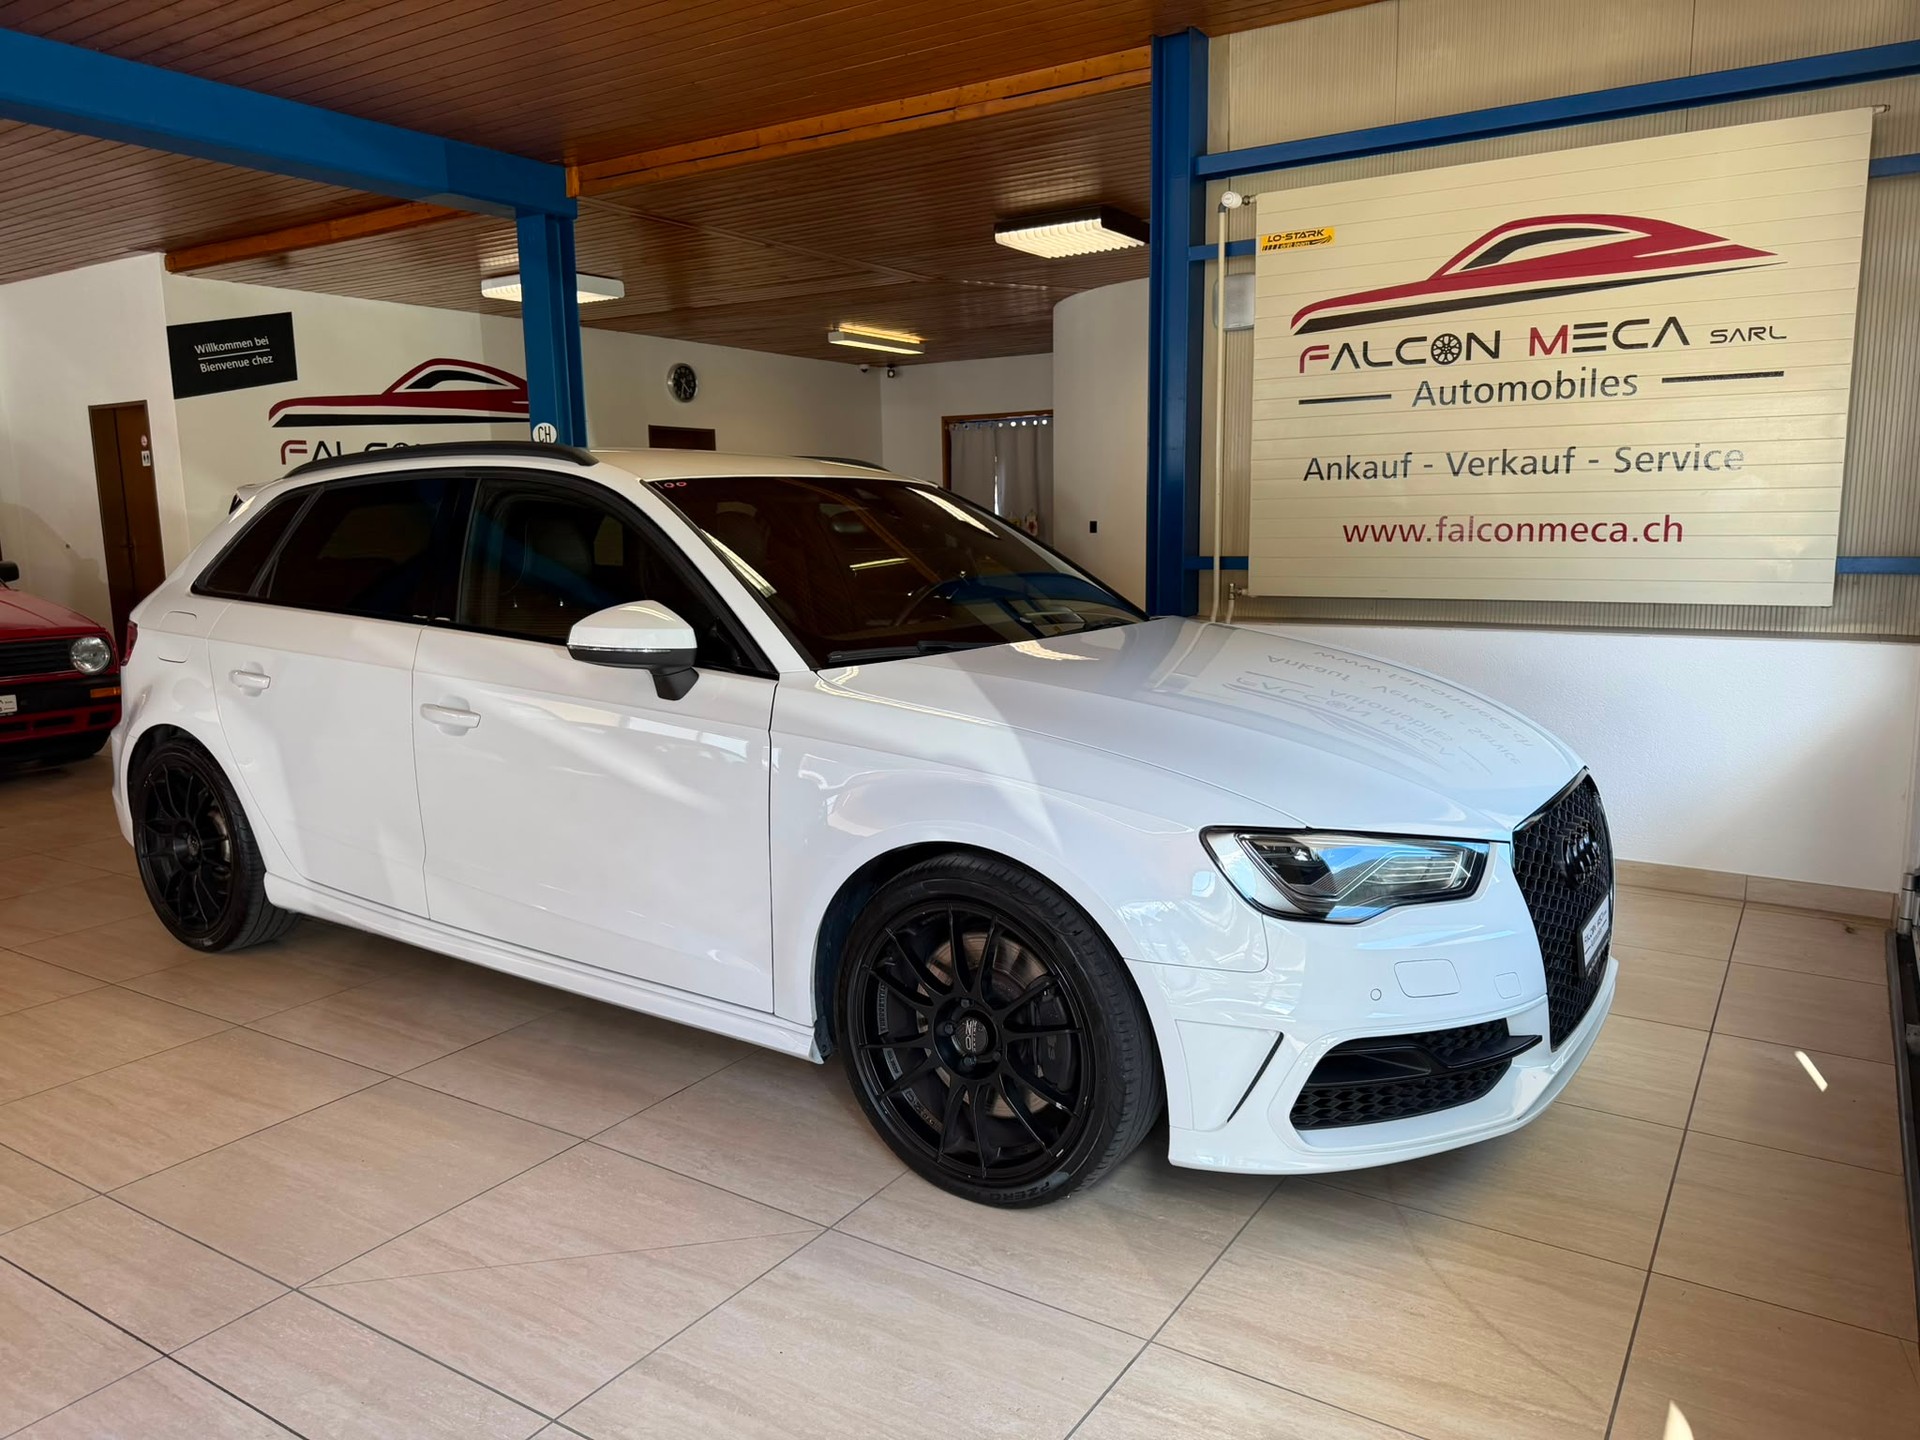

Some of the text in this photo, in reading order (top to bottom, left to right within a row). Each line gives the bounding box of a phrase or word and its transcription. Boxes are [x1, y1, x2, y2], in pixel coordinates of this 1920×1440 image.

[1267, 229, 1325, 243] LO-STARK
[194, 336, 270, 354] Willkommen bei
[1299, 316, 1787, 374] FALCON MECA SARL
[200, 355, 274, 373] Bienvenue chez
[1411, 366, 1638, 408] Automobiles
[538, 425, 552, 443] CH
[1303, 452, 1413, 481] Ankauf
[1445, 446, 1576, 477] Verkauf
[1614, 443, 1744, 473] Service
[1342, 514, 1683, 543] www.falconmeca.ch
